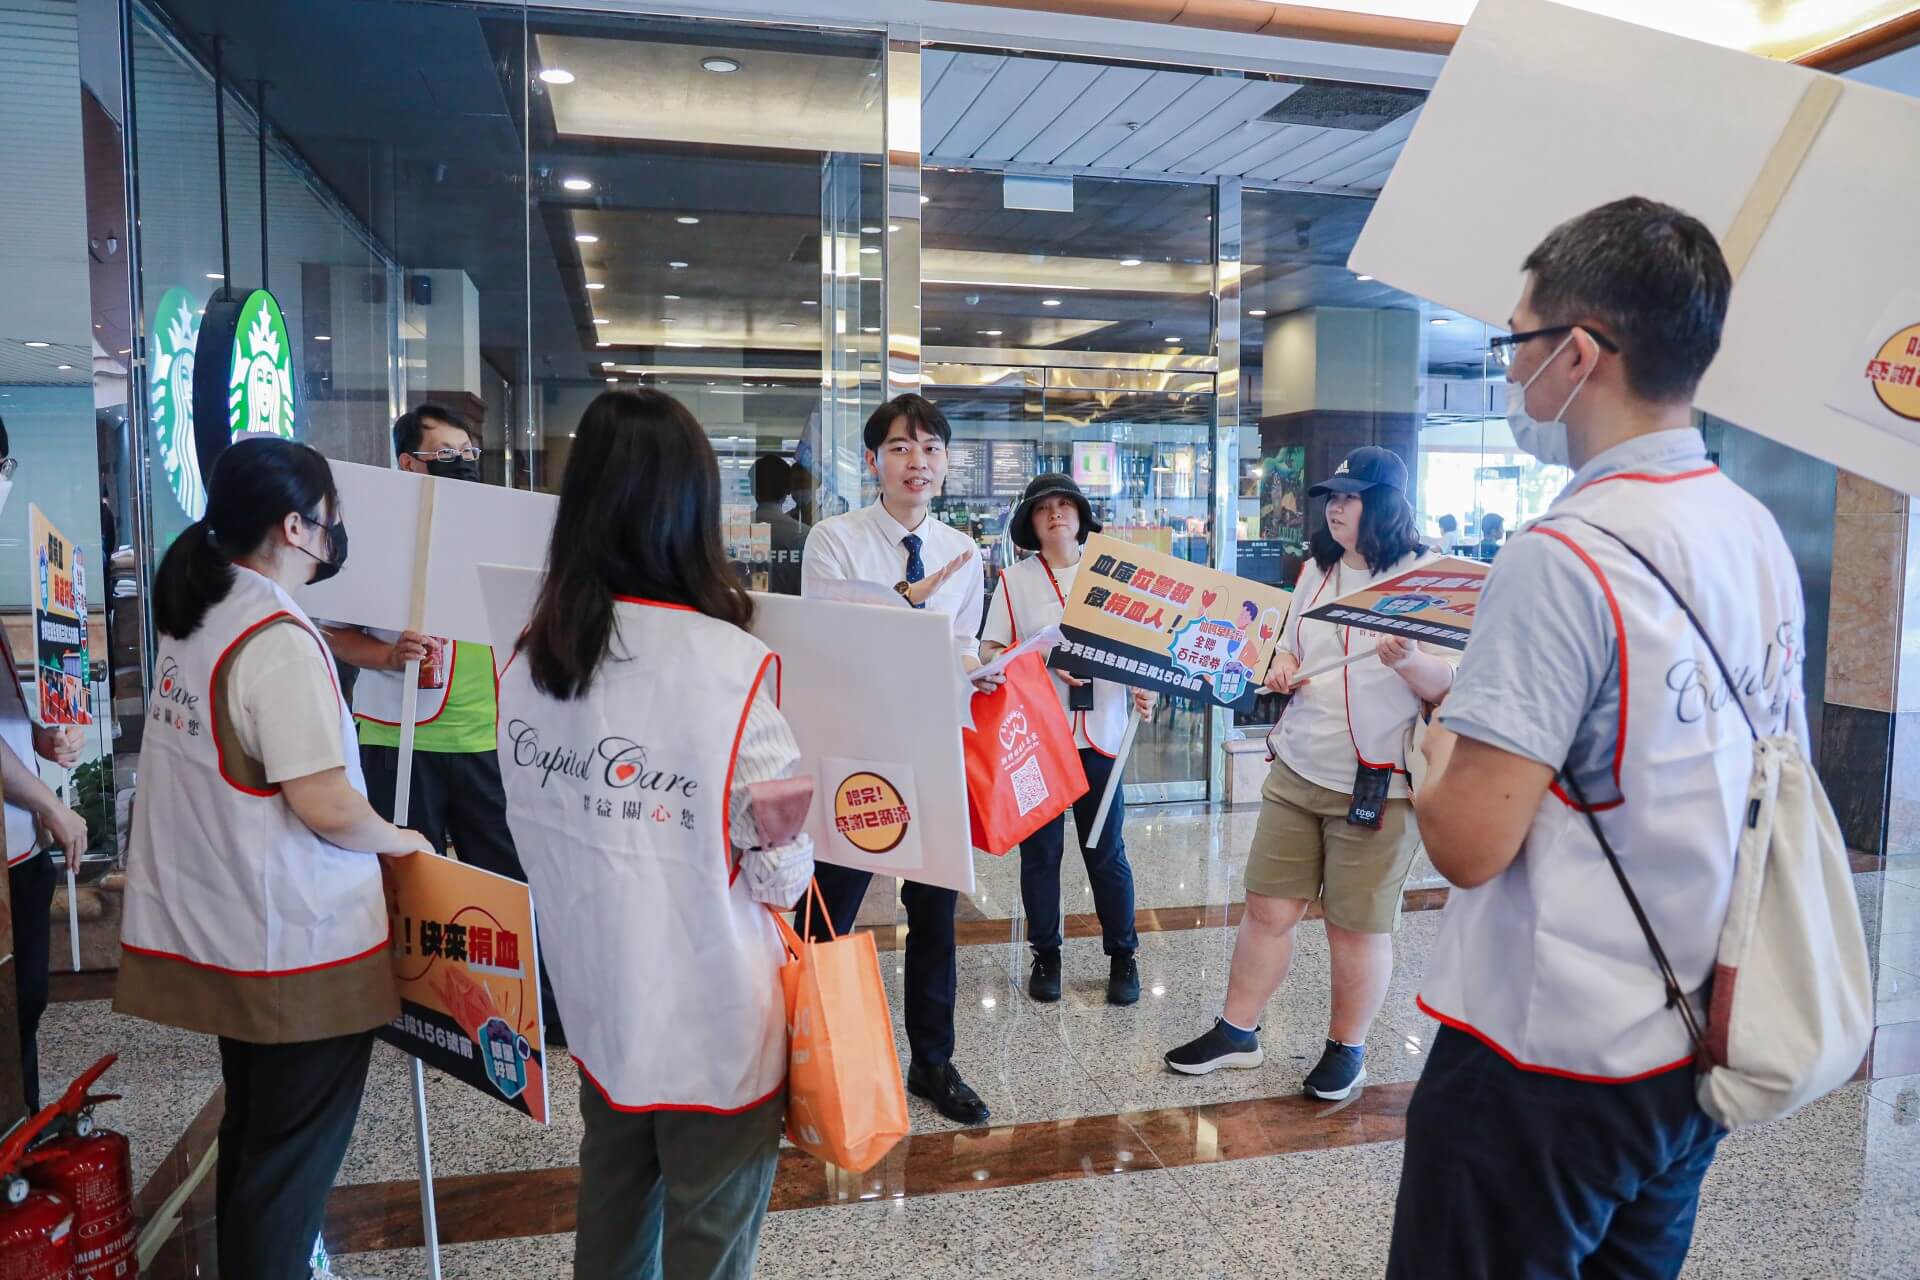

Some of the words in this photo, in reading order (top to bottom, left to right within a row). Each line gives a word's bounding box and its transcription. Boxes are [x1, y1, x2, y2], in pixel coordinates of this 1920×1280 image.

[1865, 360, 1920, 387] 感謝
[1089, 553, 1196, 606] 血庫拉警報
[1083, 586, 1183, 634] 徵捐血人！
[159, 655, 199, 711] Care
[1177, 648, 1221, 670] 百元禮券
[508, 719, 595, 788] Capital
[598, 736, 699, 798] Care
